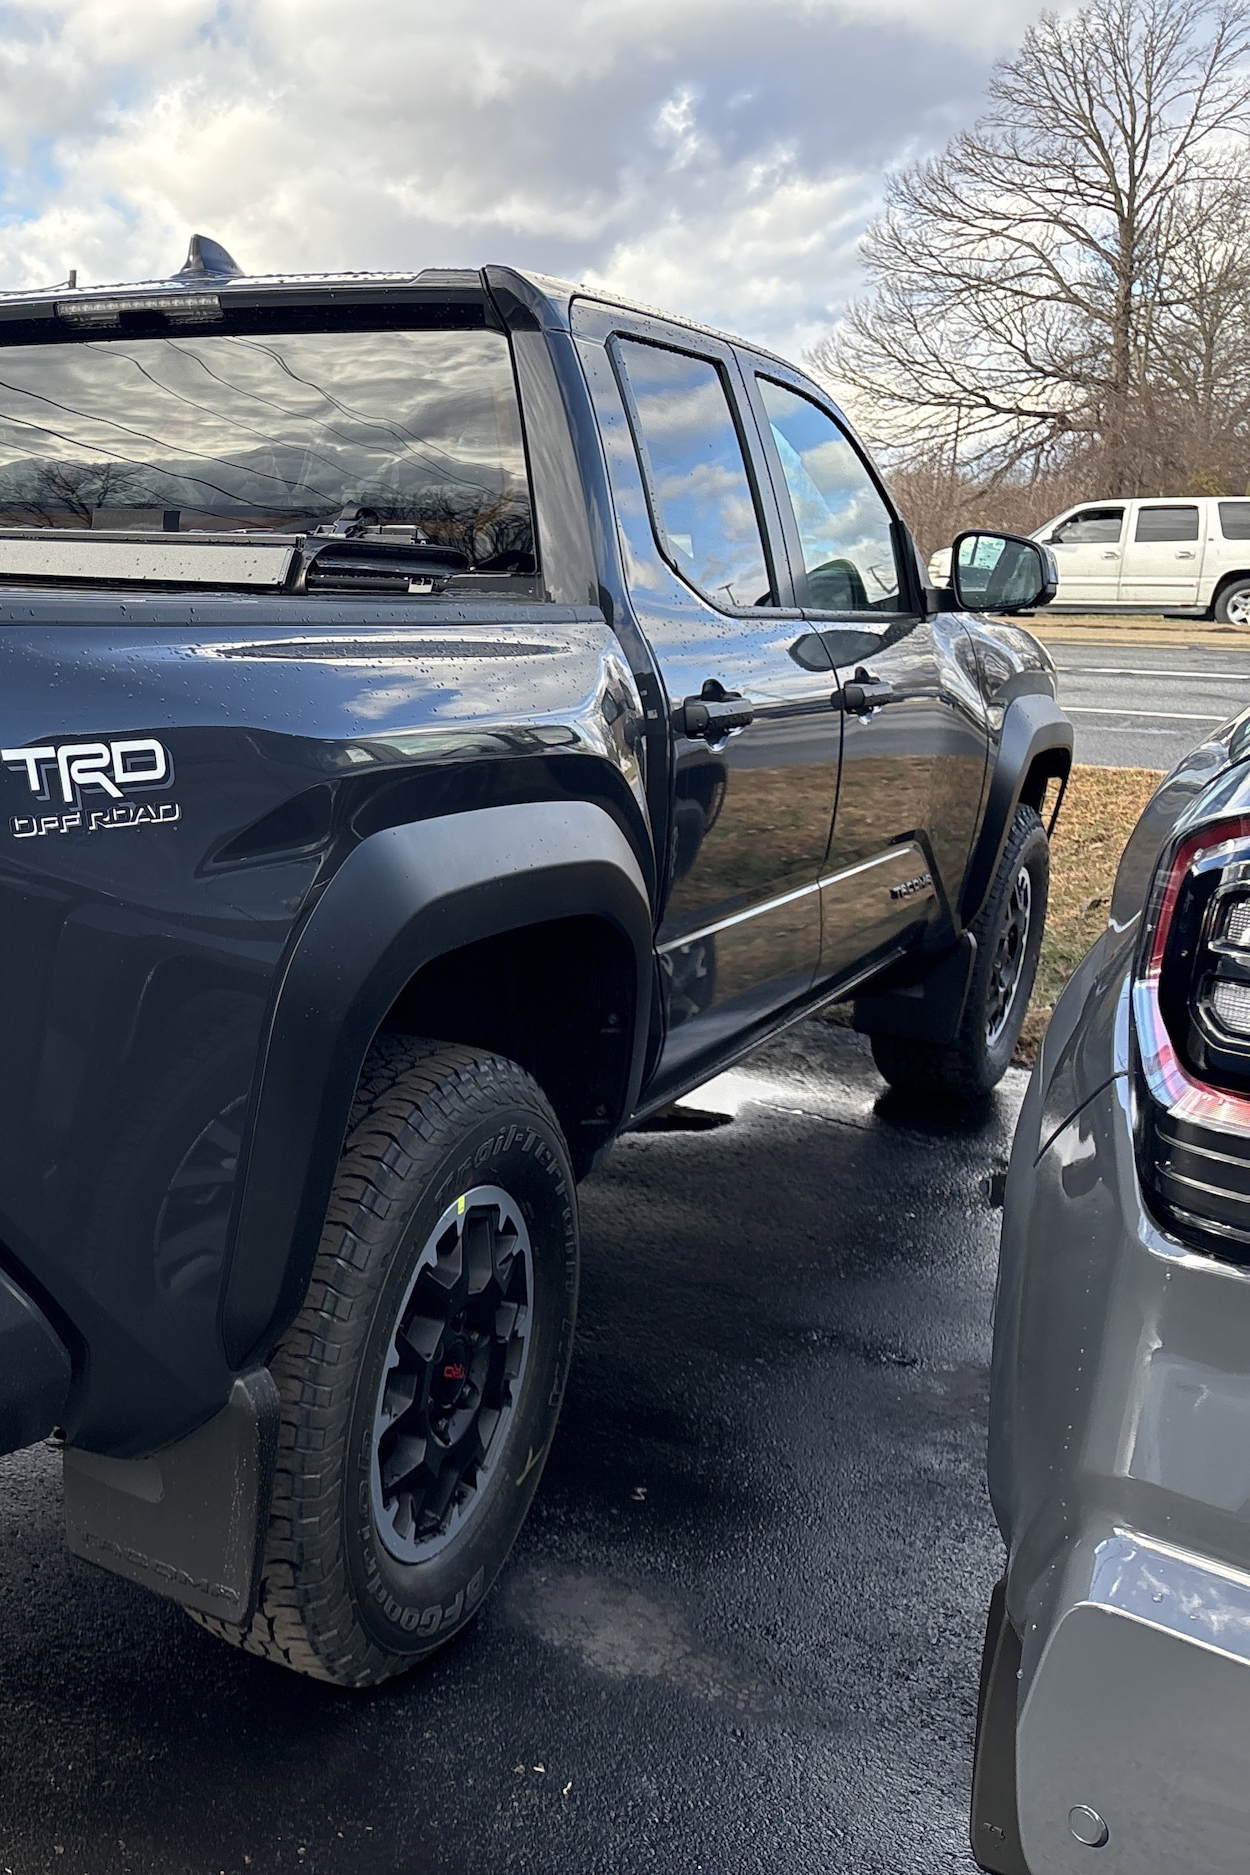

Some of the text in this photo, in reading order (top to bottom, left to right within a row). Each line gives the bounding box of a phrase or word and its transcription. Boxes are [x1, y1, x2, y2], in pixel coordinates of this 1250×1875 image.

[1, 738, 174, 808] TRD
[9, 802, 182, 838] OFF ROAD
[357, 1428, 486, 1638] BFGoodrich
